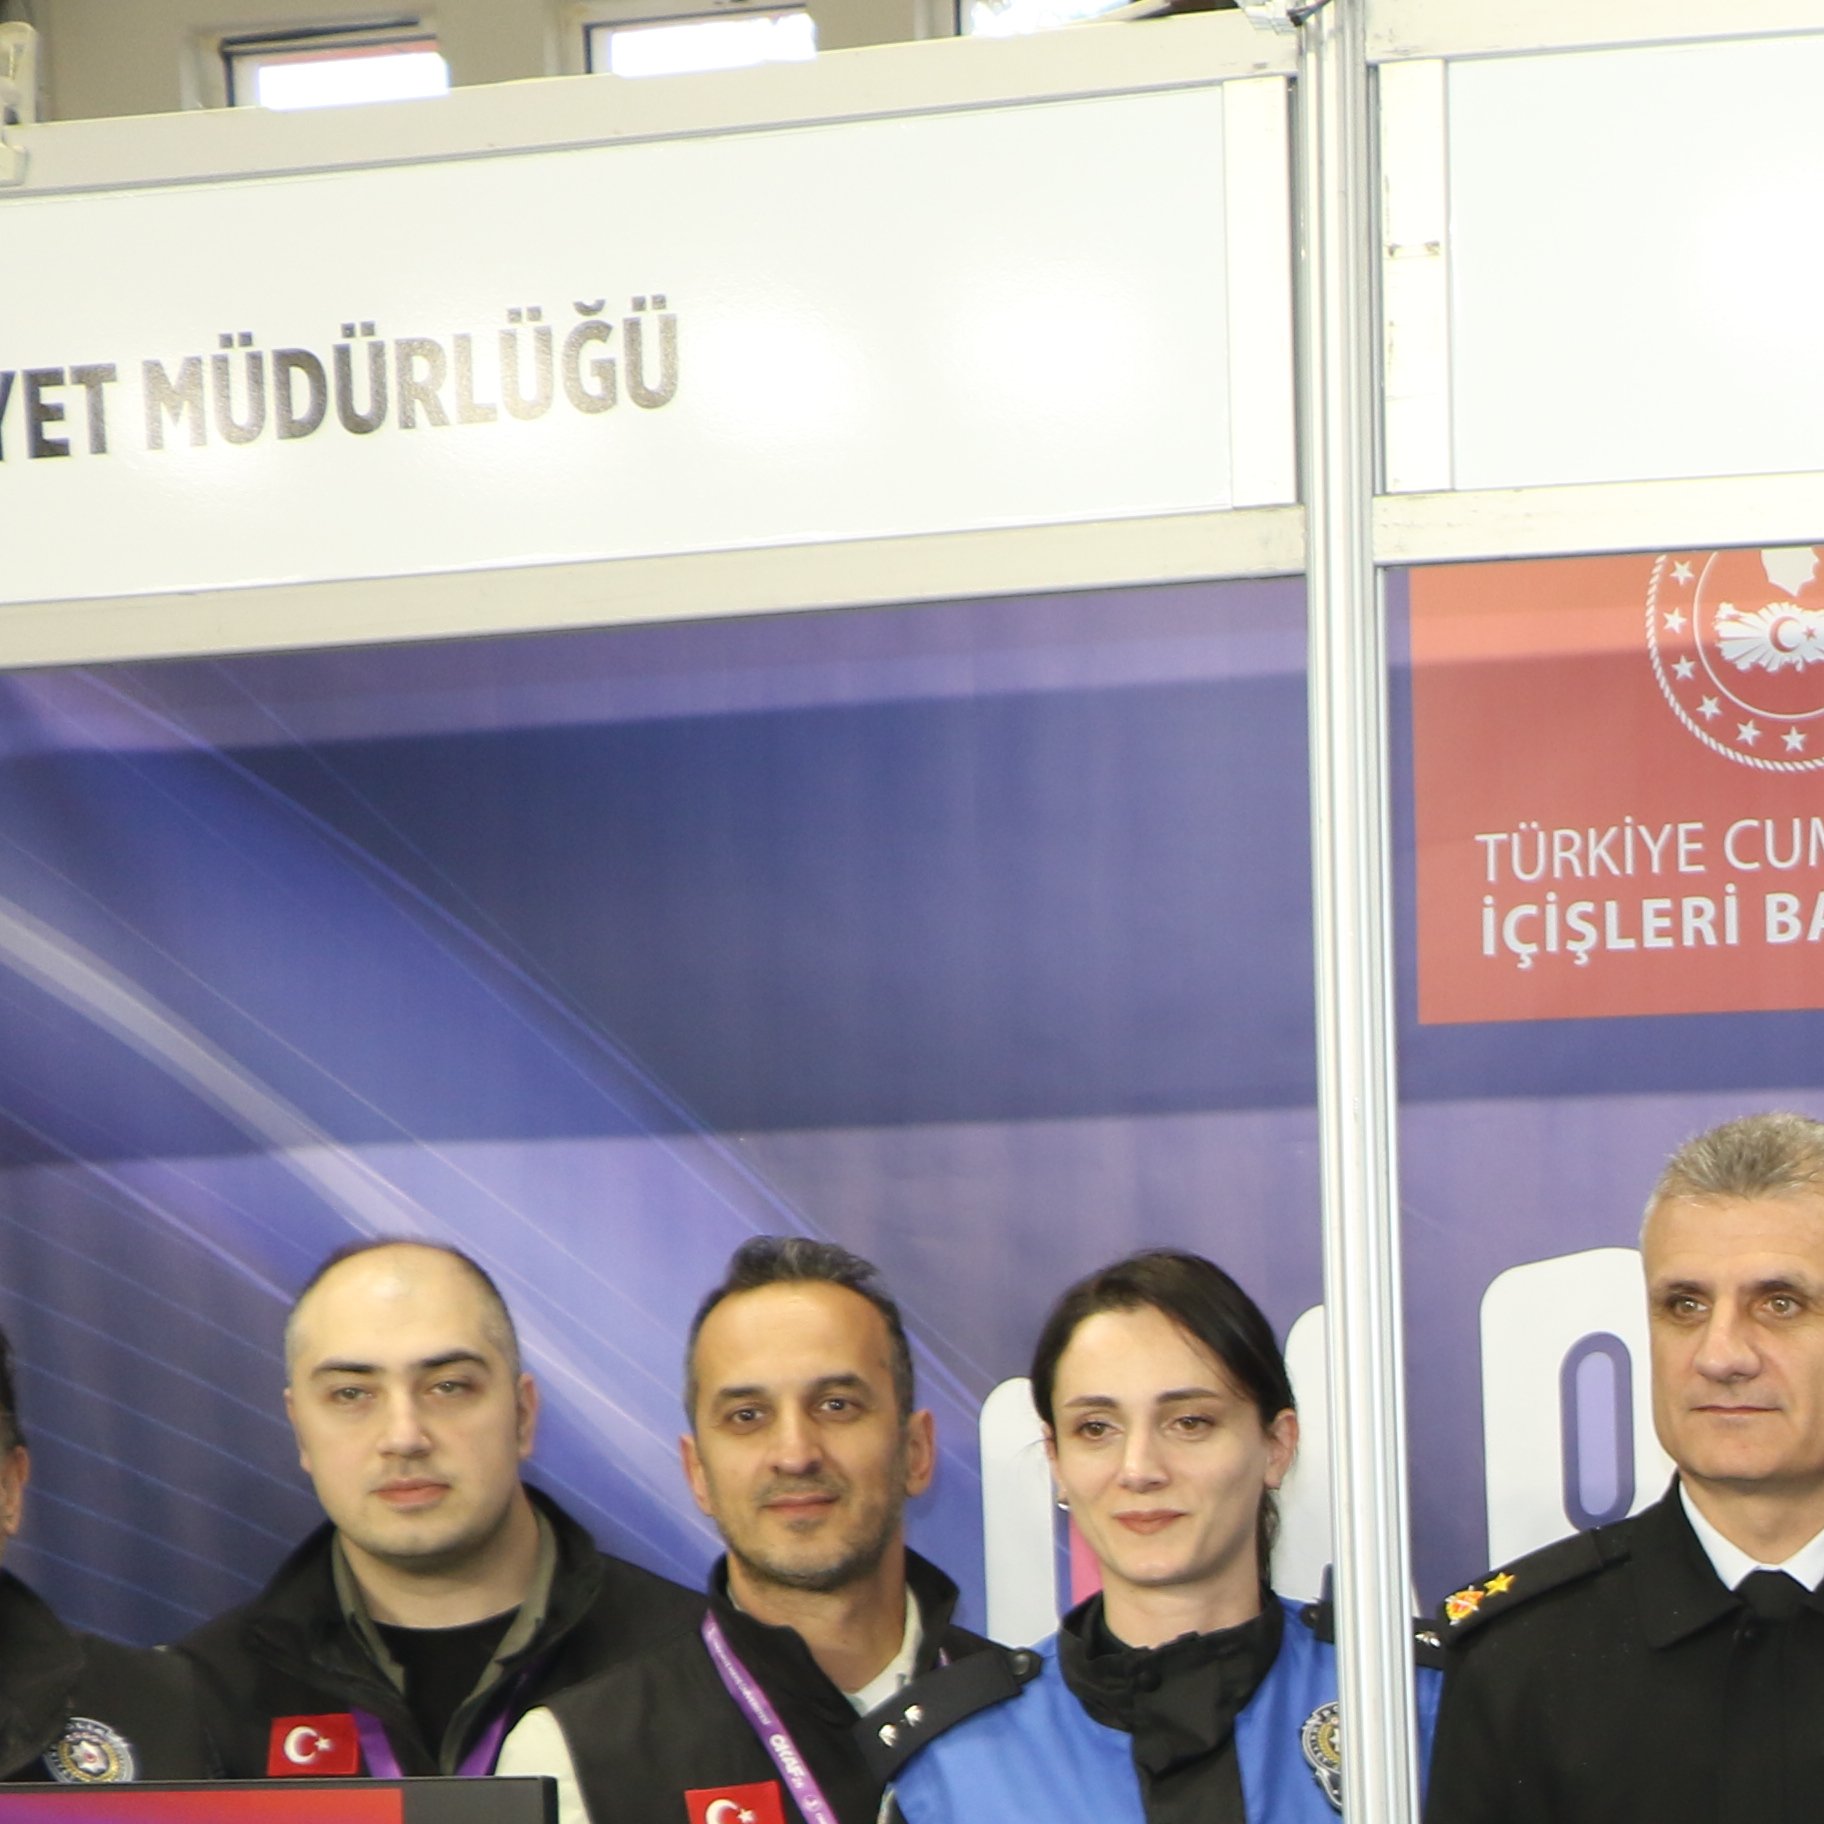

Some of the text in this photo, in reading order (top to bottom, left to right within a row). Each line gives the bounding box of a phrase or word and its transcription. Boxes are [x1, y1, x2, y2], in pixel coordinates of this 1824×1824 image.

[143, 293, 678, 451] MÜDÜRLÜĞÜ
[1475, 815, 1706, 882] TÜRKİYE
[1481, 883, 1740, 968] İÇİŞLERİ
